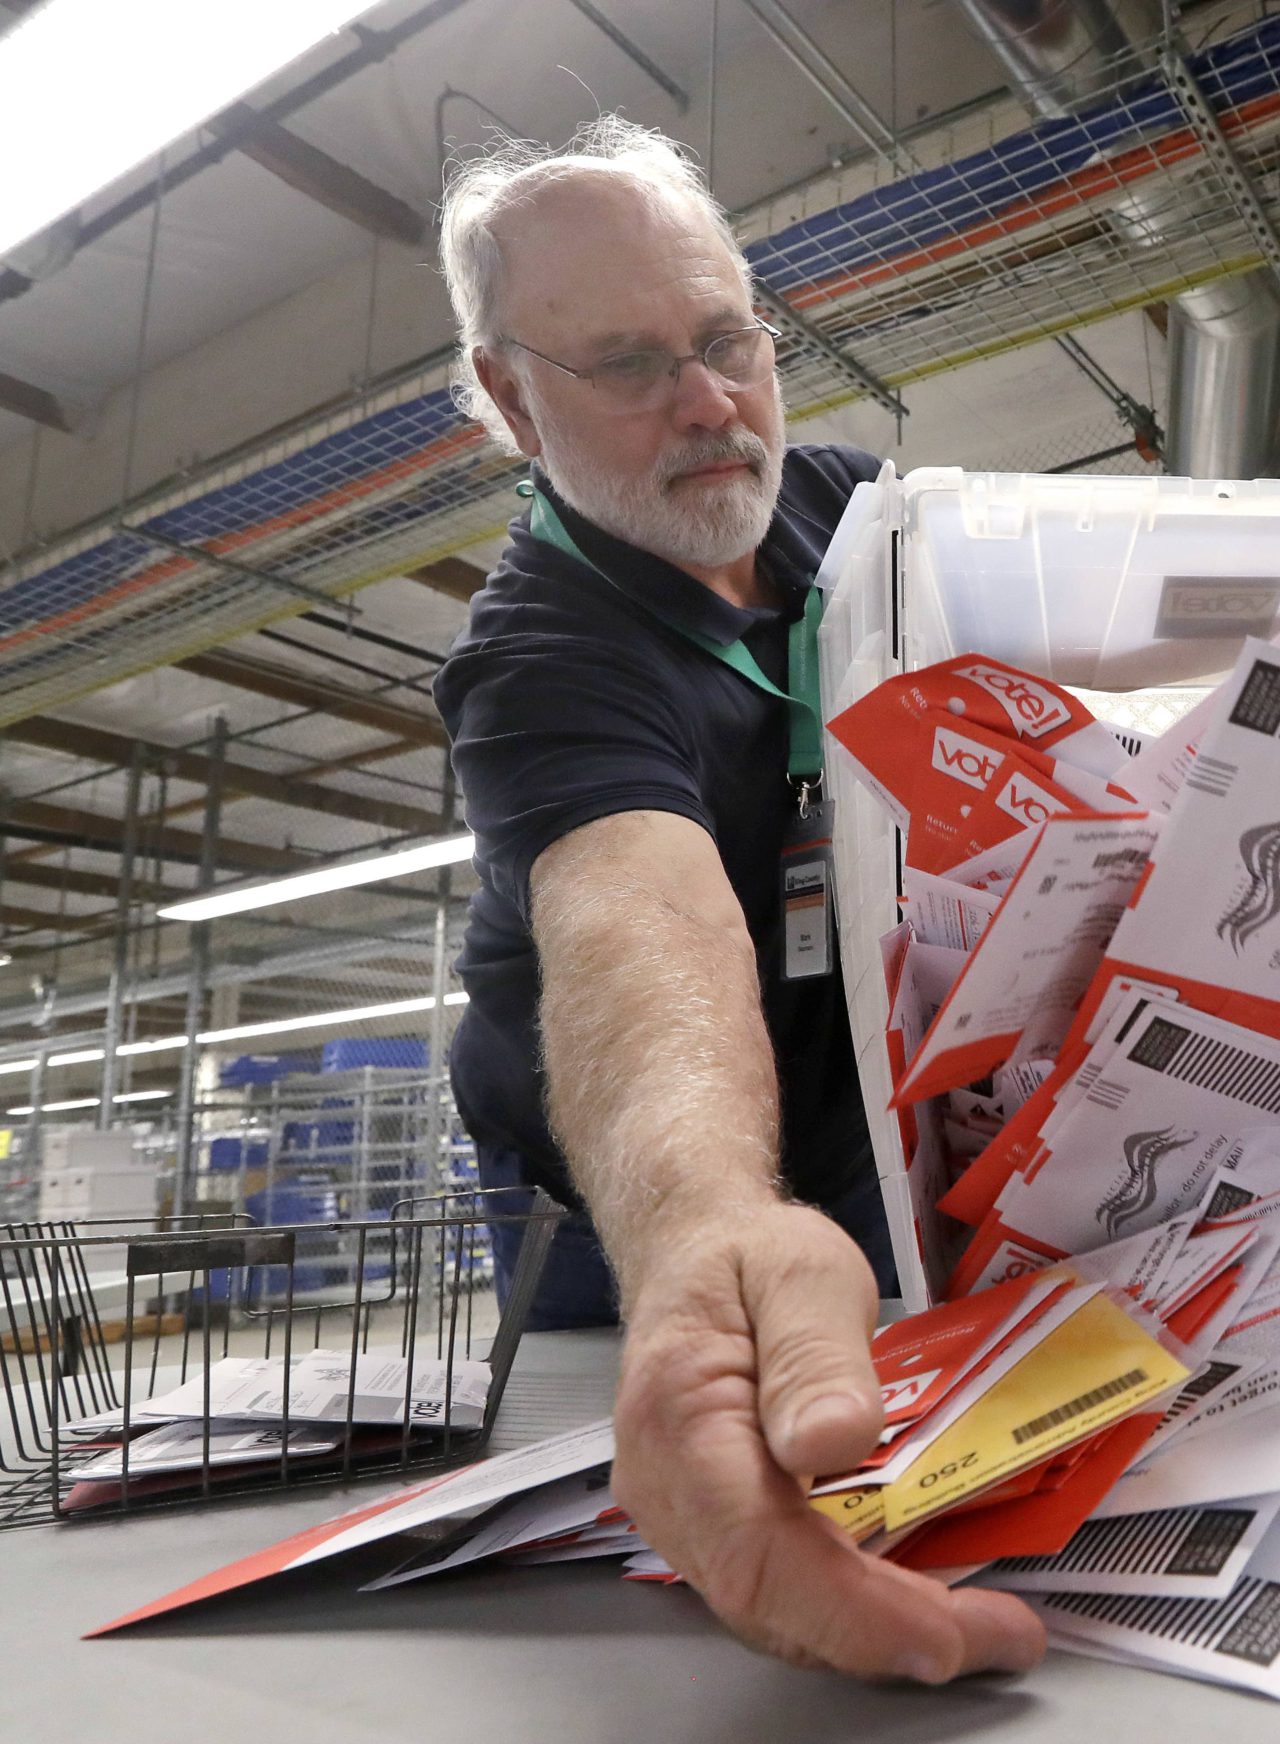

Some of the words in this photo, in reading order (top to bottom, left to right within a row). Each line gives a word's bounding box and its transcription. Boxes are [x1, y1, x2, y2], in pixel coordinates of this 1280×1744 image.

[968, 668, 1062, 730] vote!
[1182, 1179, 1196, 1192] do
[1194, 1160, 1208, 1177] not
[1203, 1134, 1228, 1160] delay
[1246, 1369, 1279, 1388] can
[1205, 1404, 1226, 1417] to
[916, 1450, 981, 1491] 250
